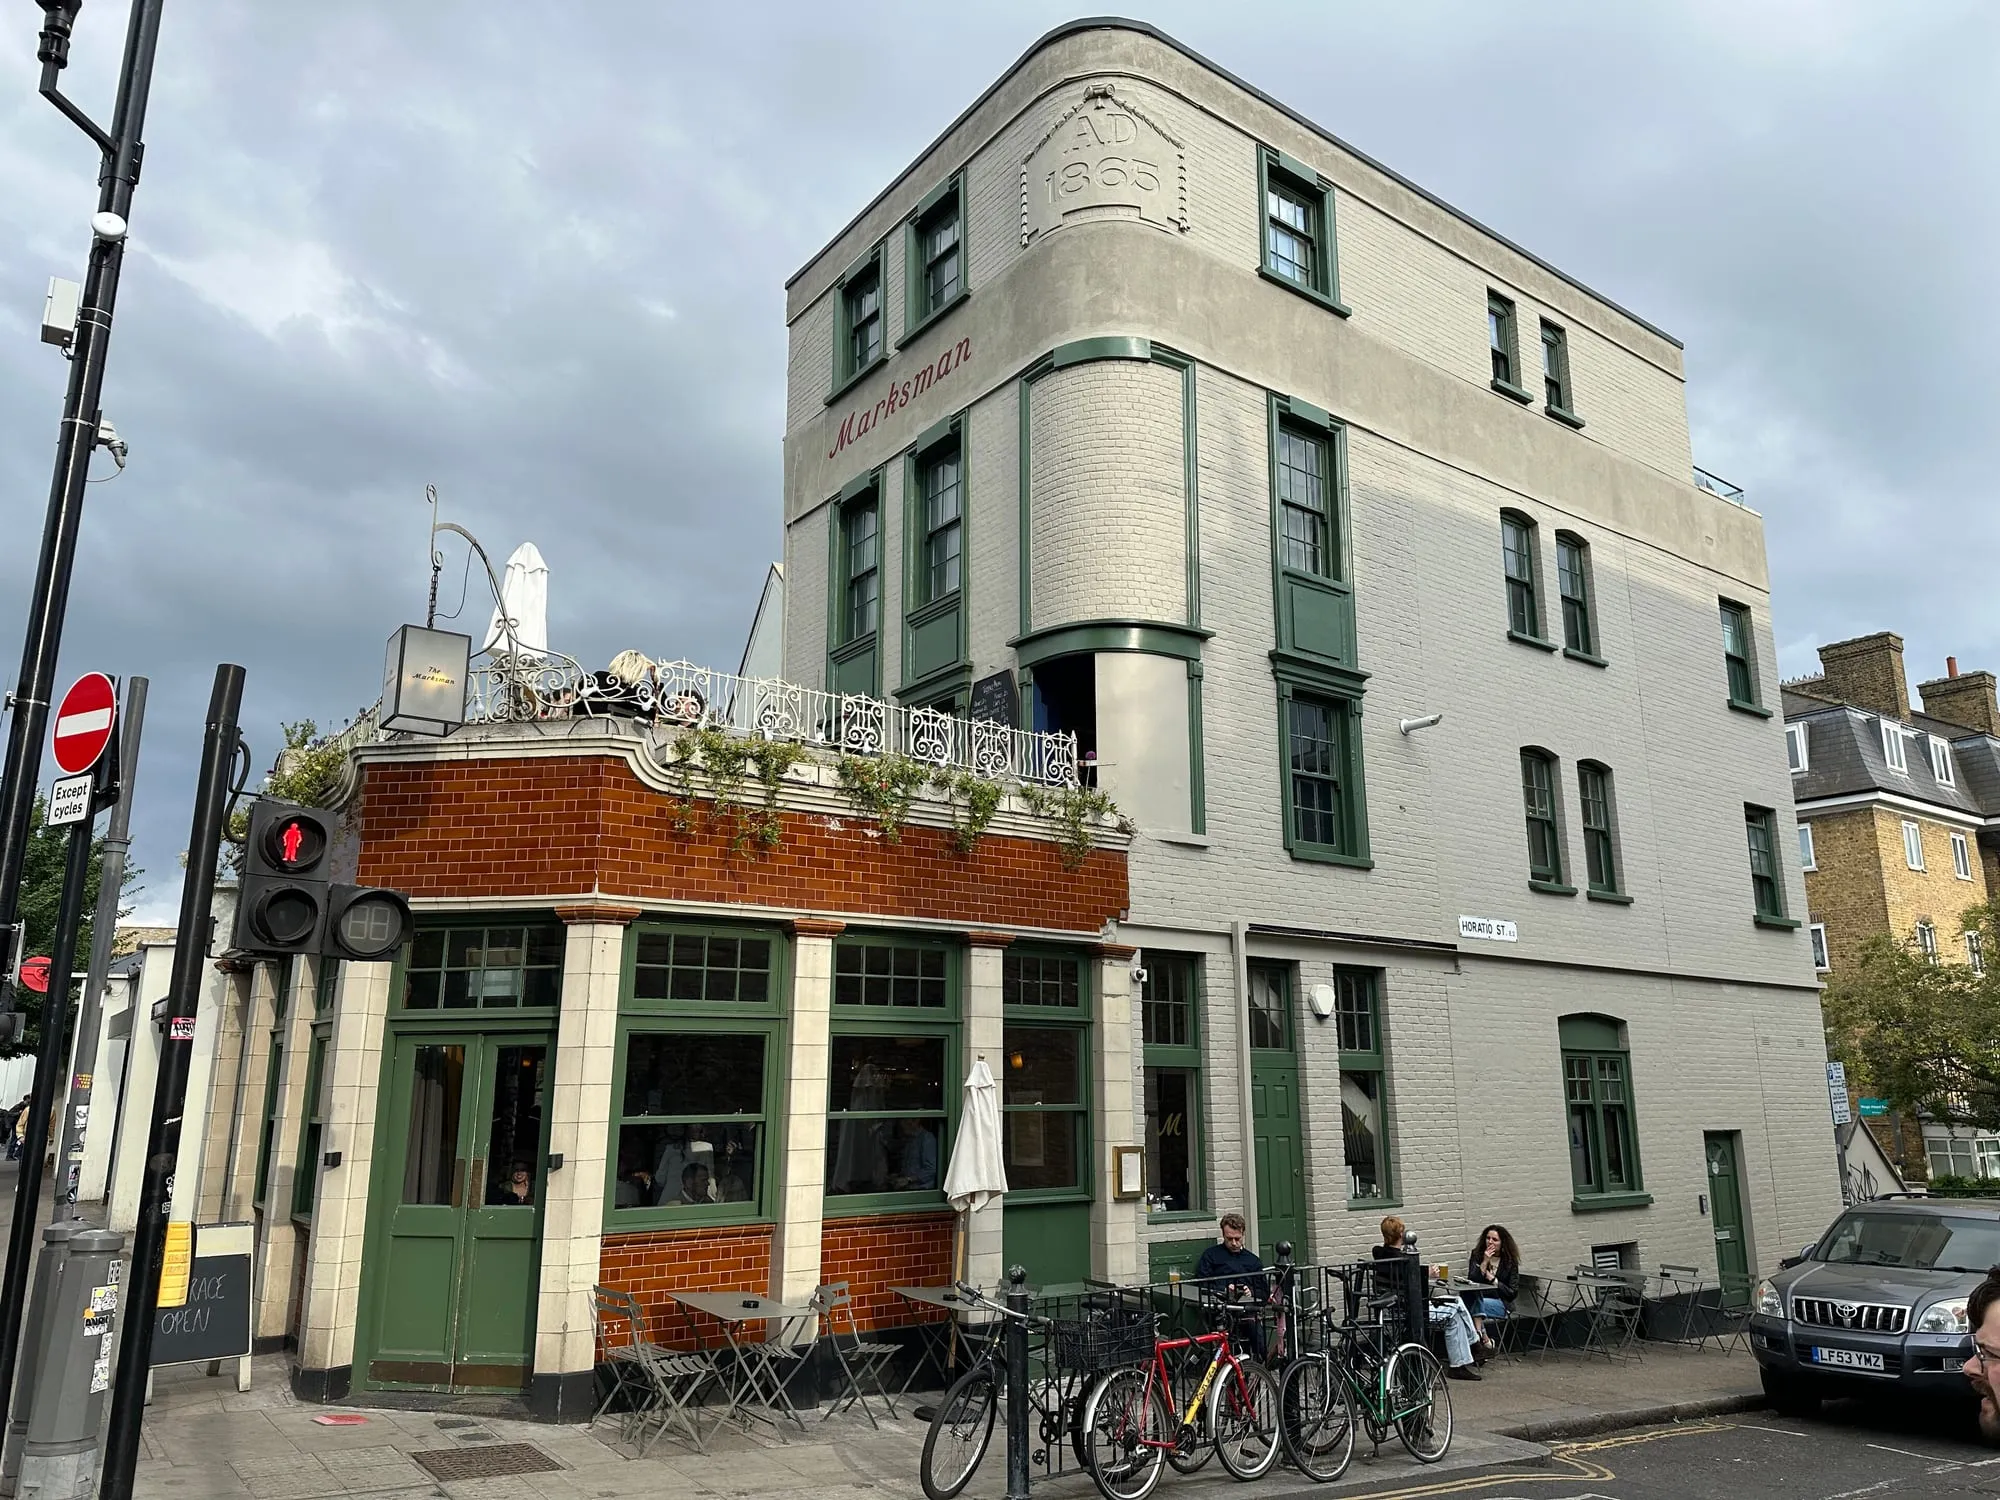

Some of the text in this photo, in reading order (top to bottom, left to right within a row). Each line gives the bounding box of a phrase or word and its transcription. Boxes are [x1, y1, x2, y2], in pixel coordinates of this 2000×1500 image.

[1044, 156, 1161, 204] 1865
[829, 337, 972, 460] Marksman
[412, 673, 455, 685] Marksman
[427, 666, 441, 674] The
[56, 781, 88, 800] Except
[54, 801, 83, 819] cycles
[1462, 921, 1493, 934] HORATIO
[161, 1307, 211, 1335] OPEN
[1820, 1349, 1881, 1367] LF53 YMZ
